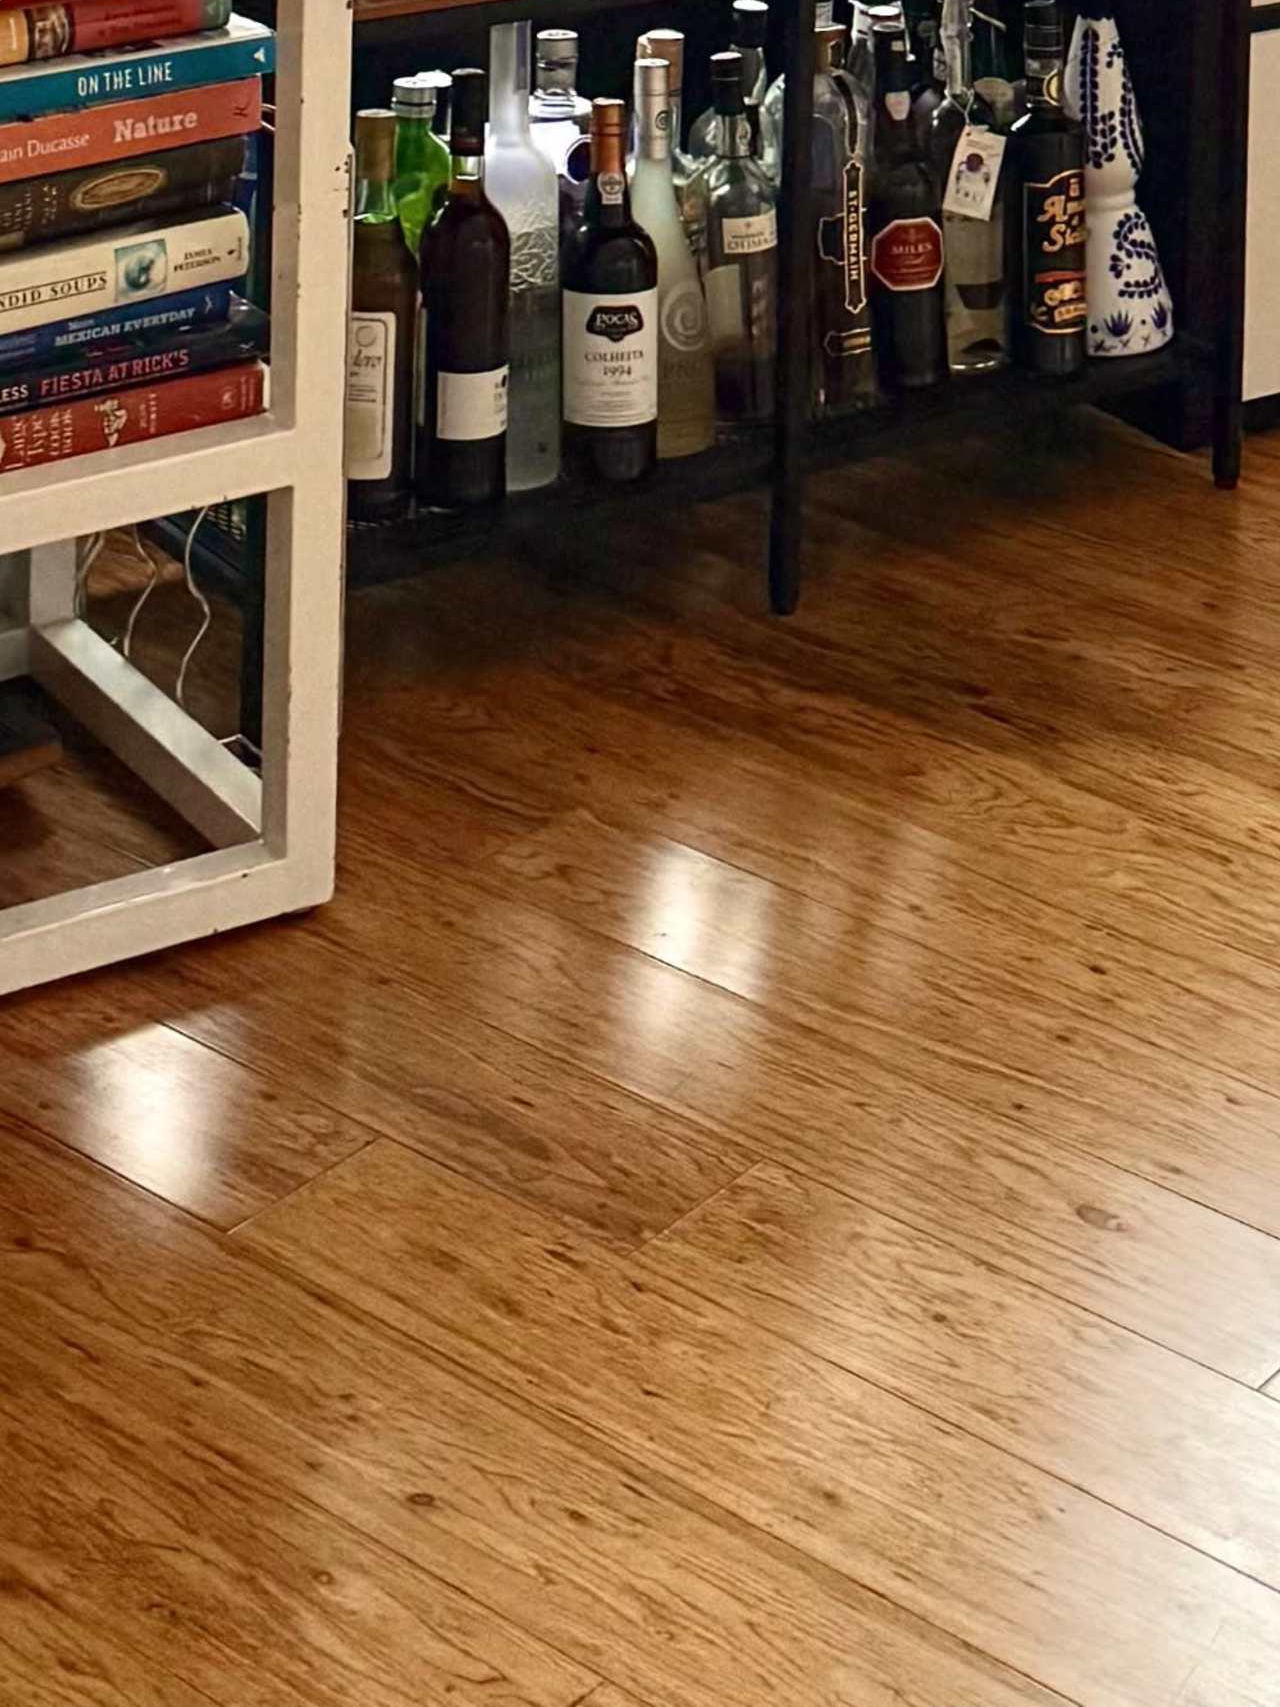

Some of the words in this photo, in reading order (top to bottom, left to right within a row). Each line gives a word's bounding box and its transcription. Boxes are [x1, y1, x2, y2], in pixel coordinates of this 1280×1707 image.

[77, 74, 100, 97] ON
[102, 66, 133, 92] THE
[137, 62, 174, 85] LINE
[27, 131, 91, 158] Ducasse
[112, 110, 198, 144] Nature
[890, 240, 935, 255] MILES
[583, 348, 646, 364] COLHEITA
[602, 363, 634, 378] 1994
